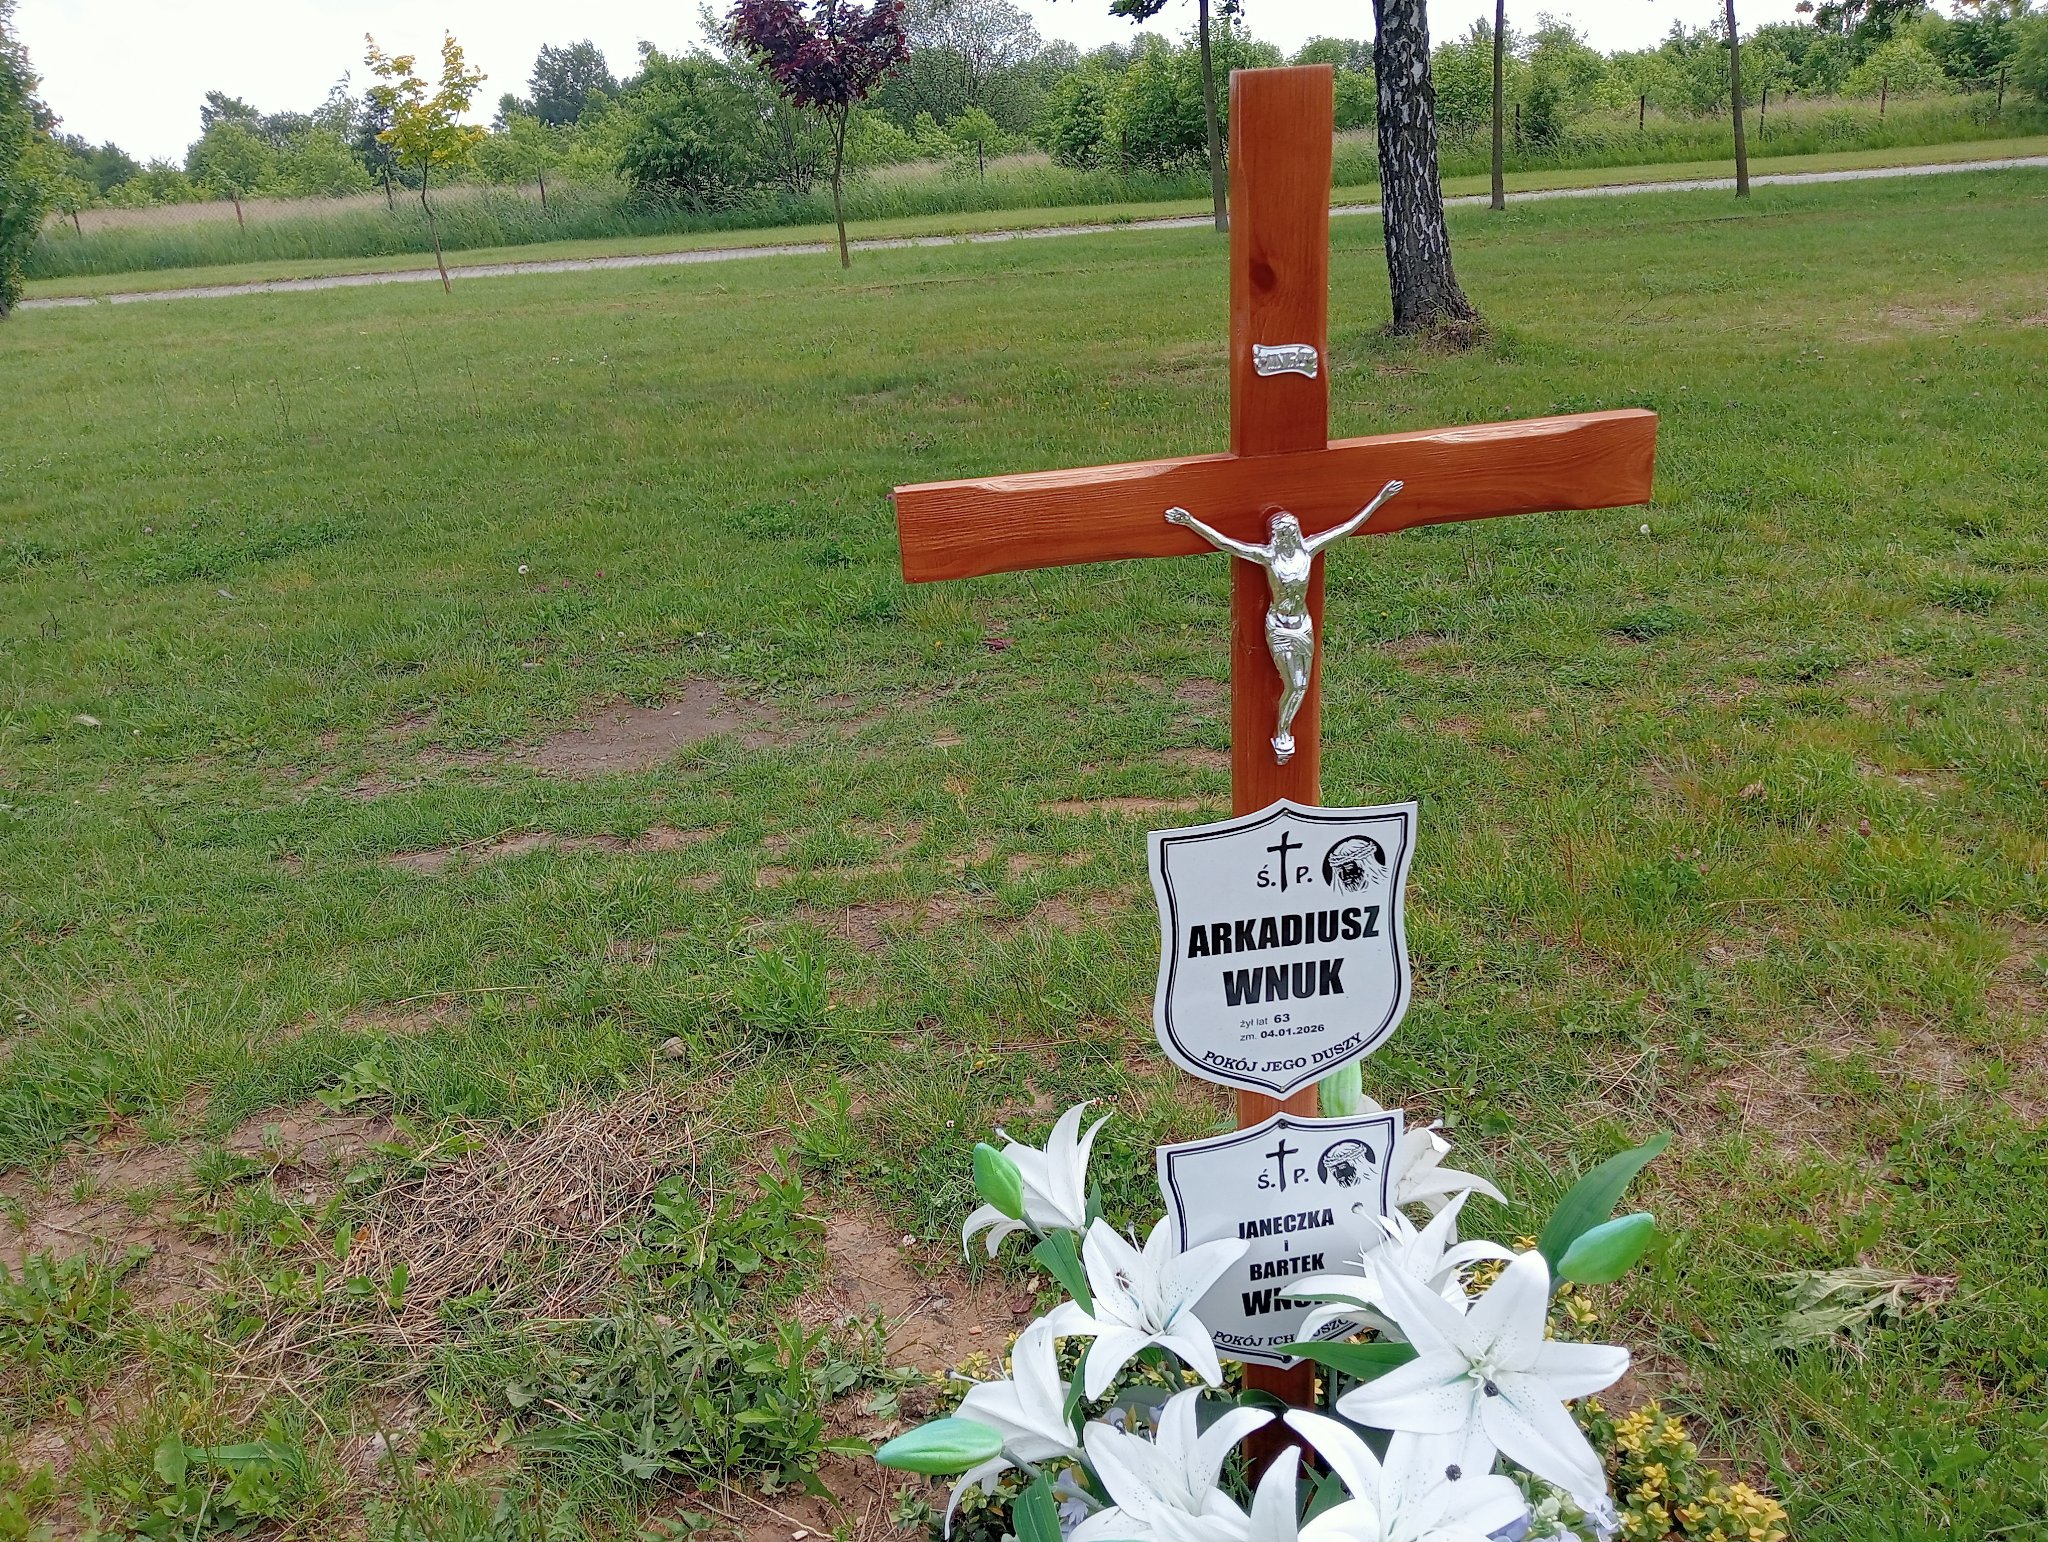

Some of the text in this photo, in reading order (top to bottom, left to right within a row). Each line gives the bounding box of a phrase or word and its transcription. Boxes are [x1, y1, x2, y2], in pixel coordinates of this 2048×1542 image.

[1257, 864, 1313, 888] Ś. P.
[1187, 905, 1380, 958] ARKADIUSZ
[1222, 957, 1344, 1007] WNUK
[1239, 1013, 1290, 1029] żył lat 63
[1239, 1024, 1325, 1042] zm. 04.01.2026
[1202, 1031, 1363, 1072] POKÓJ JEGO DUSZY
[1257, 1168, 1309, 1189] Ś. P.
[1238, 1208, 1335, 1240] JANECZKA
[1283, 1239, 1289, 1252] i
[1249, 1252, 1325, 1281] BARTEK
[1241, 1286, 1328, 1317] WN
[1213, 1330, 1263, 1347] POKÓJ
[1266, 1333, 1296, 1346] ICH
